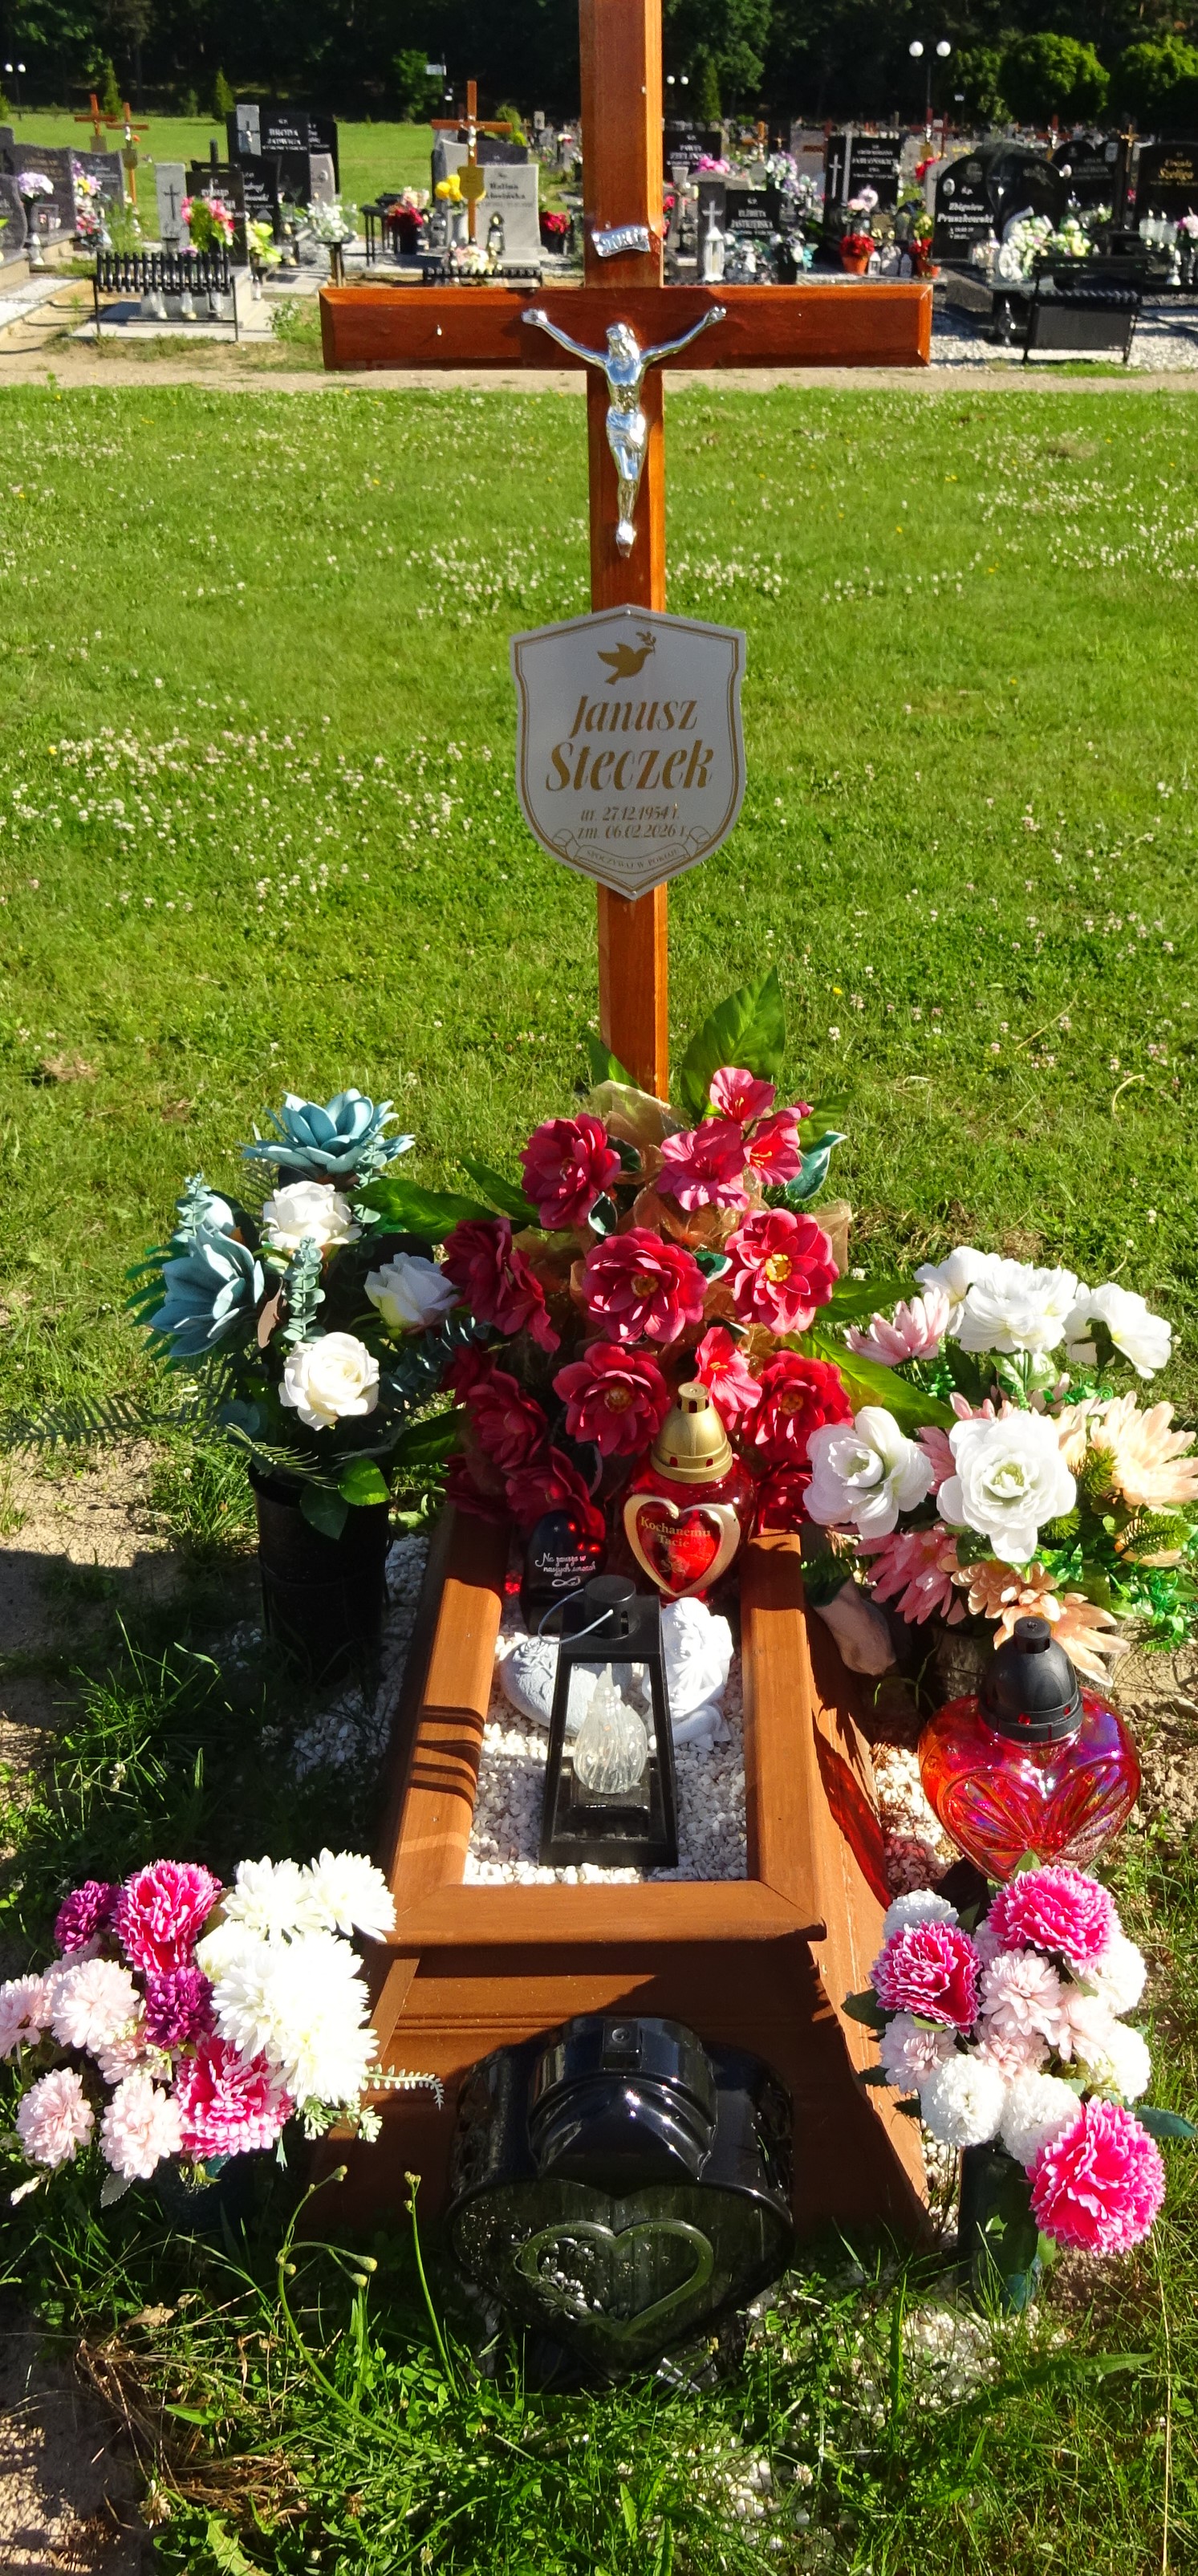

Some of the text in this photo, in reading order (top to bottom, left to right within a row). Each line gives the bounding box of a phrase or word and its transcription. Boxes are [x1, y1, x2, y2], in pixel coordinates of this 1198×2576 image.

[568, 695, 699, 739] Janusz
[545, 739, 714, 791] Steczek
[640, 1515, 712, 1538] Kochanemu
[658, 1534, 691, 1548] Tacie
[534, 1551, 555, 1567] Na
